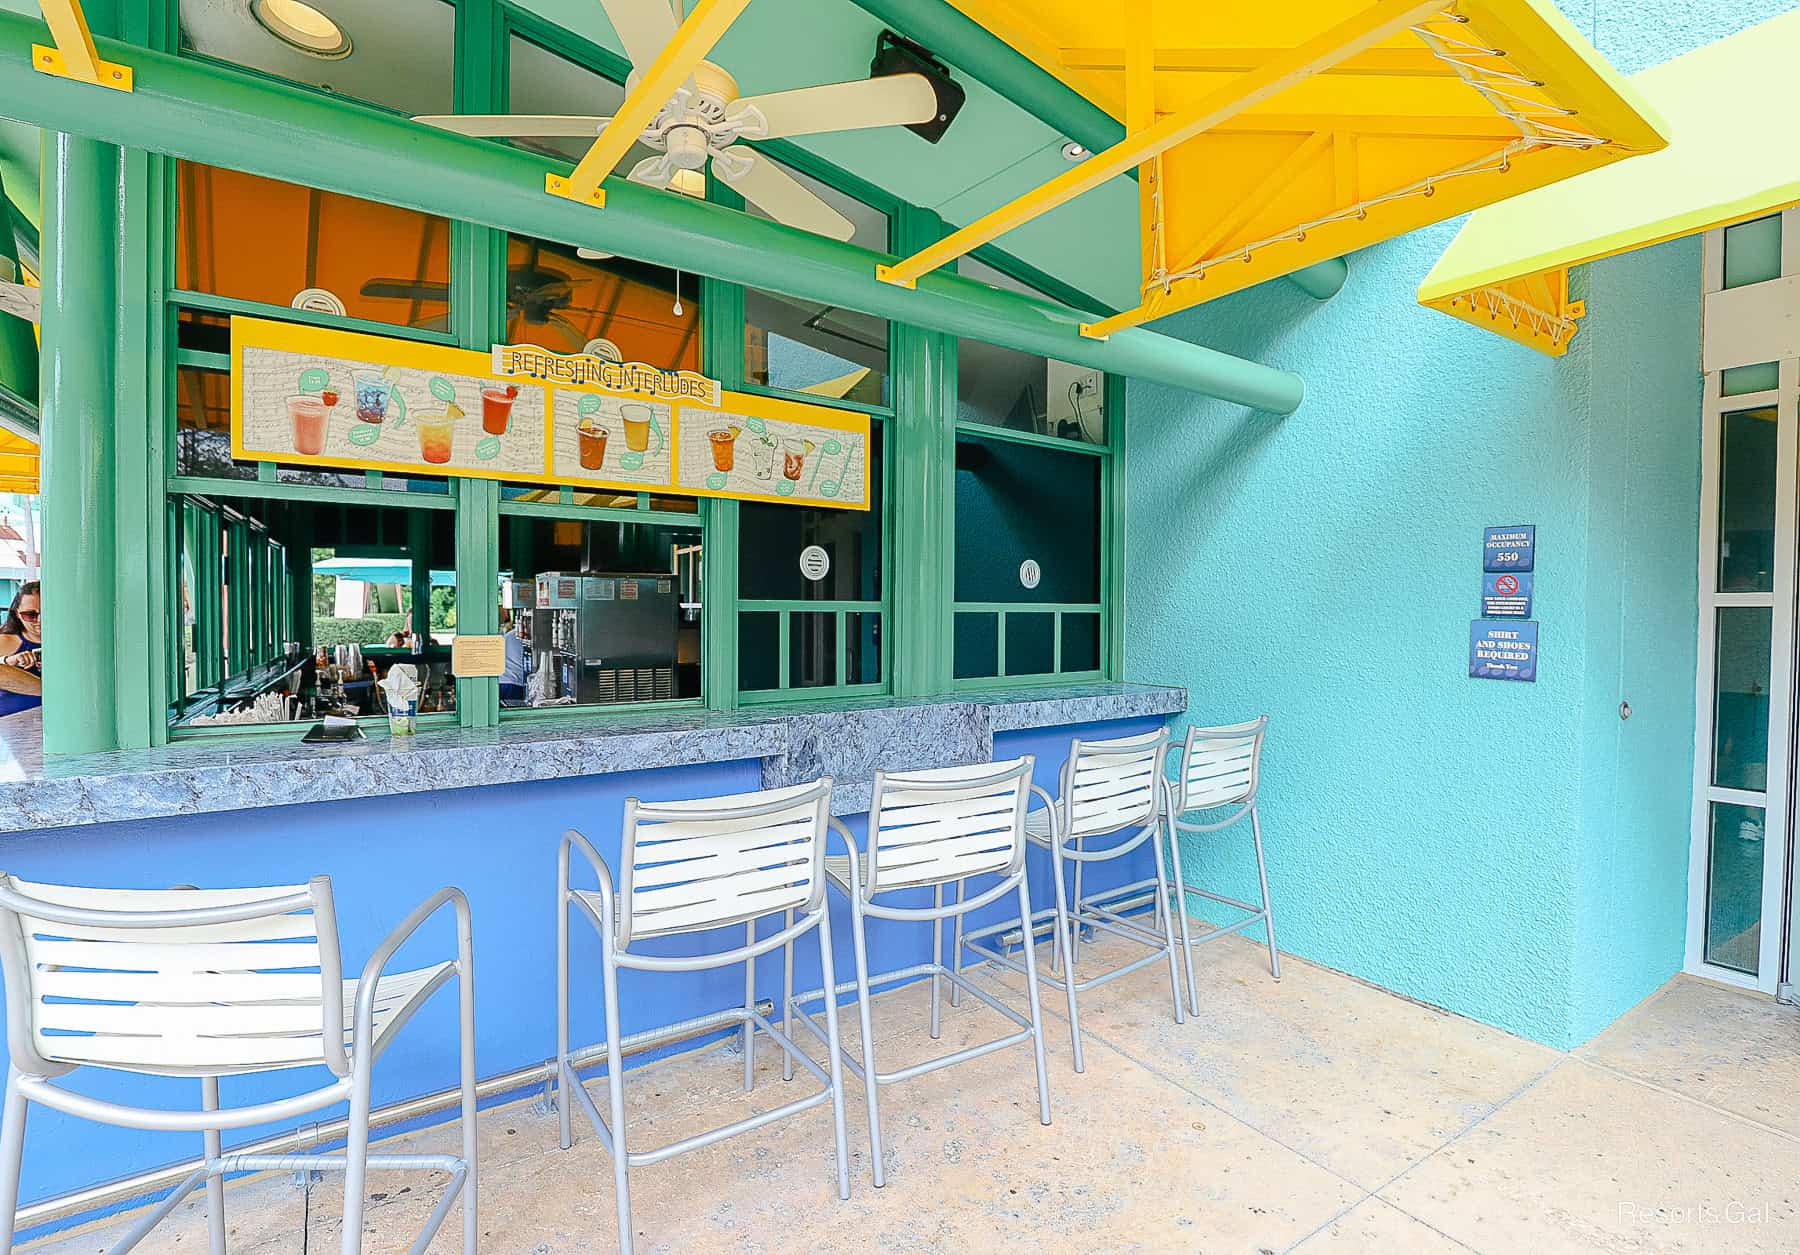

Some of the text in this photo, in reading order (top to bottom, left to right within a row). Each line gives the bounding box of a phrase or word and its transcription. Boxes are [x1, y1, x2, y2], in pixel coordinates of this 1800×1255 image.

[508, 351, 706, 397] REFRESHING INTERLUDES
[1486, 540, 1530, 548] OCCUPANCY
[1497, 552, 1518, 561] 550
[1488, 630, 1519, 639] SHIRT
[1477, 640, 1531, 650] AND SHOES
[1477, 650, 1529, 661] REQUIRED
